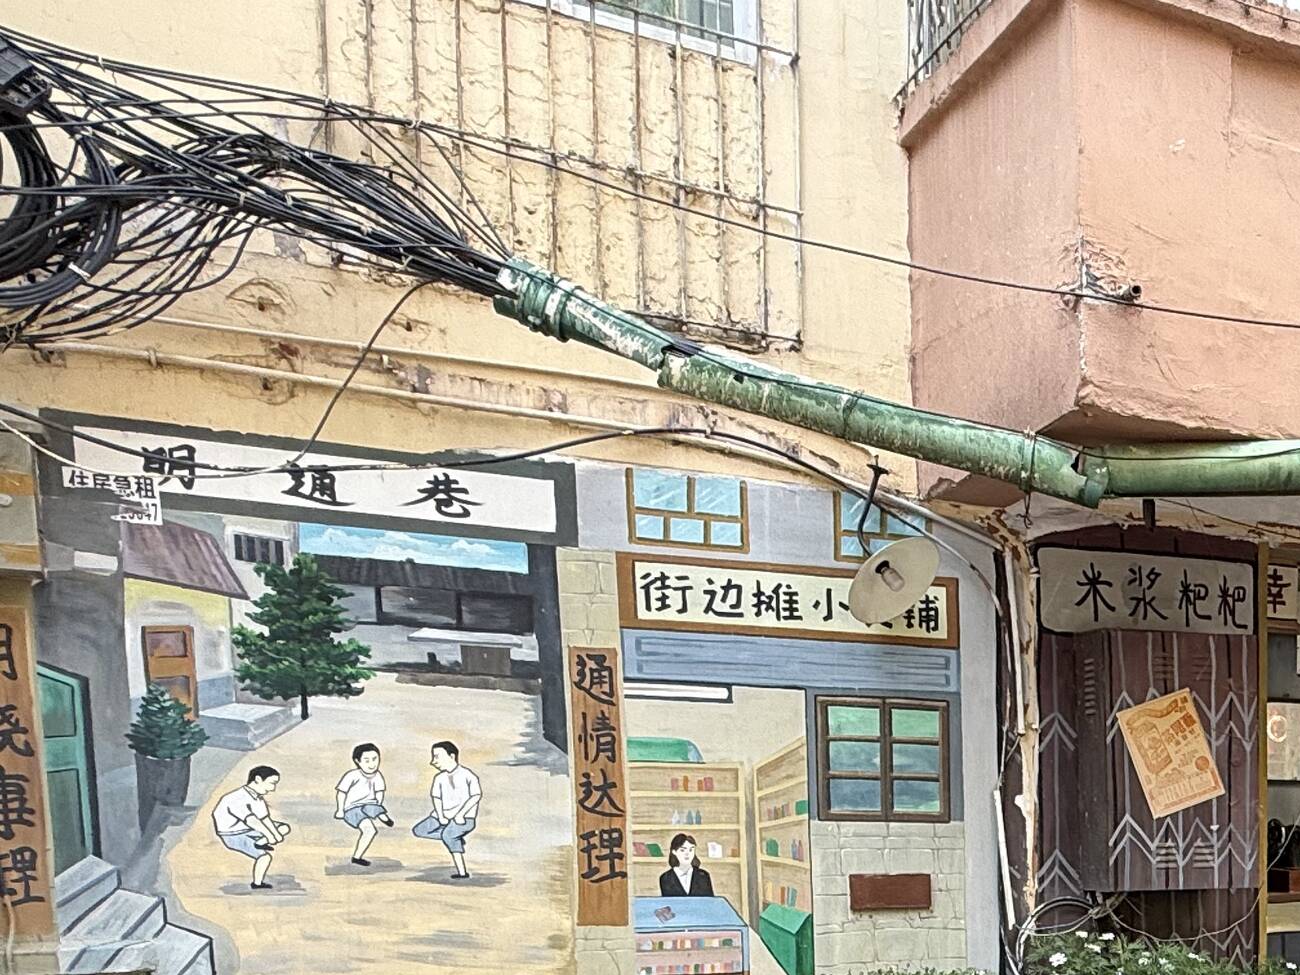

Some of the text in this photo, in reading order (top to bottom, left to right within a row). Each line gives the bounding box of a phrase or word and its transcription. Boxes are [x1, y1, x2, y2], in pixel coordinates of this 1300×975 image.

[142, 444, 485, 518] 明通巷
[639, 570, 940, 634] 街边摊小铺
[1074, 561, 1249, 629] 米浆粑粑
[573, 652, 628, 884] 通情达理
